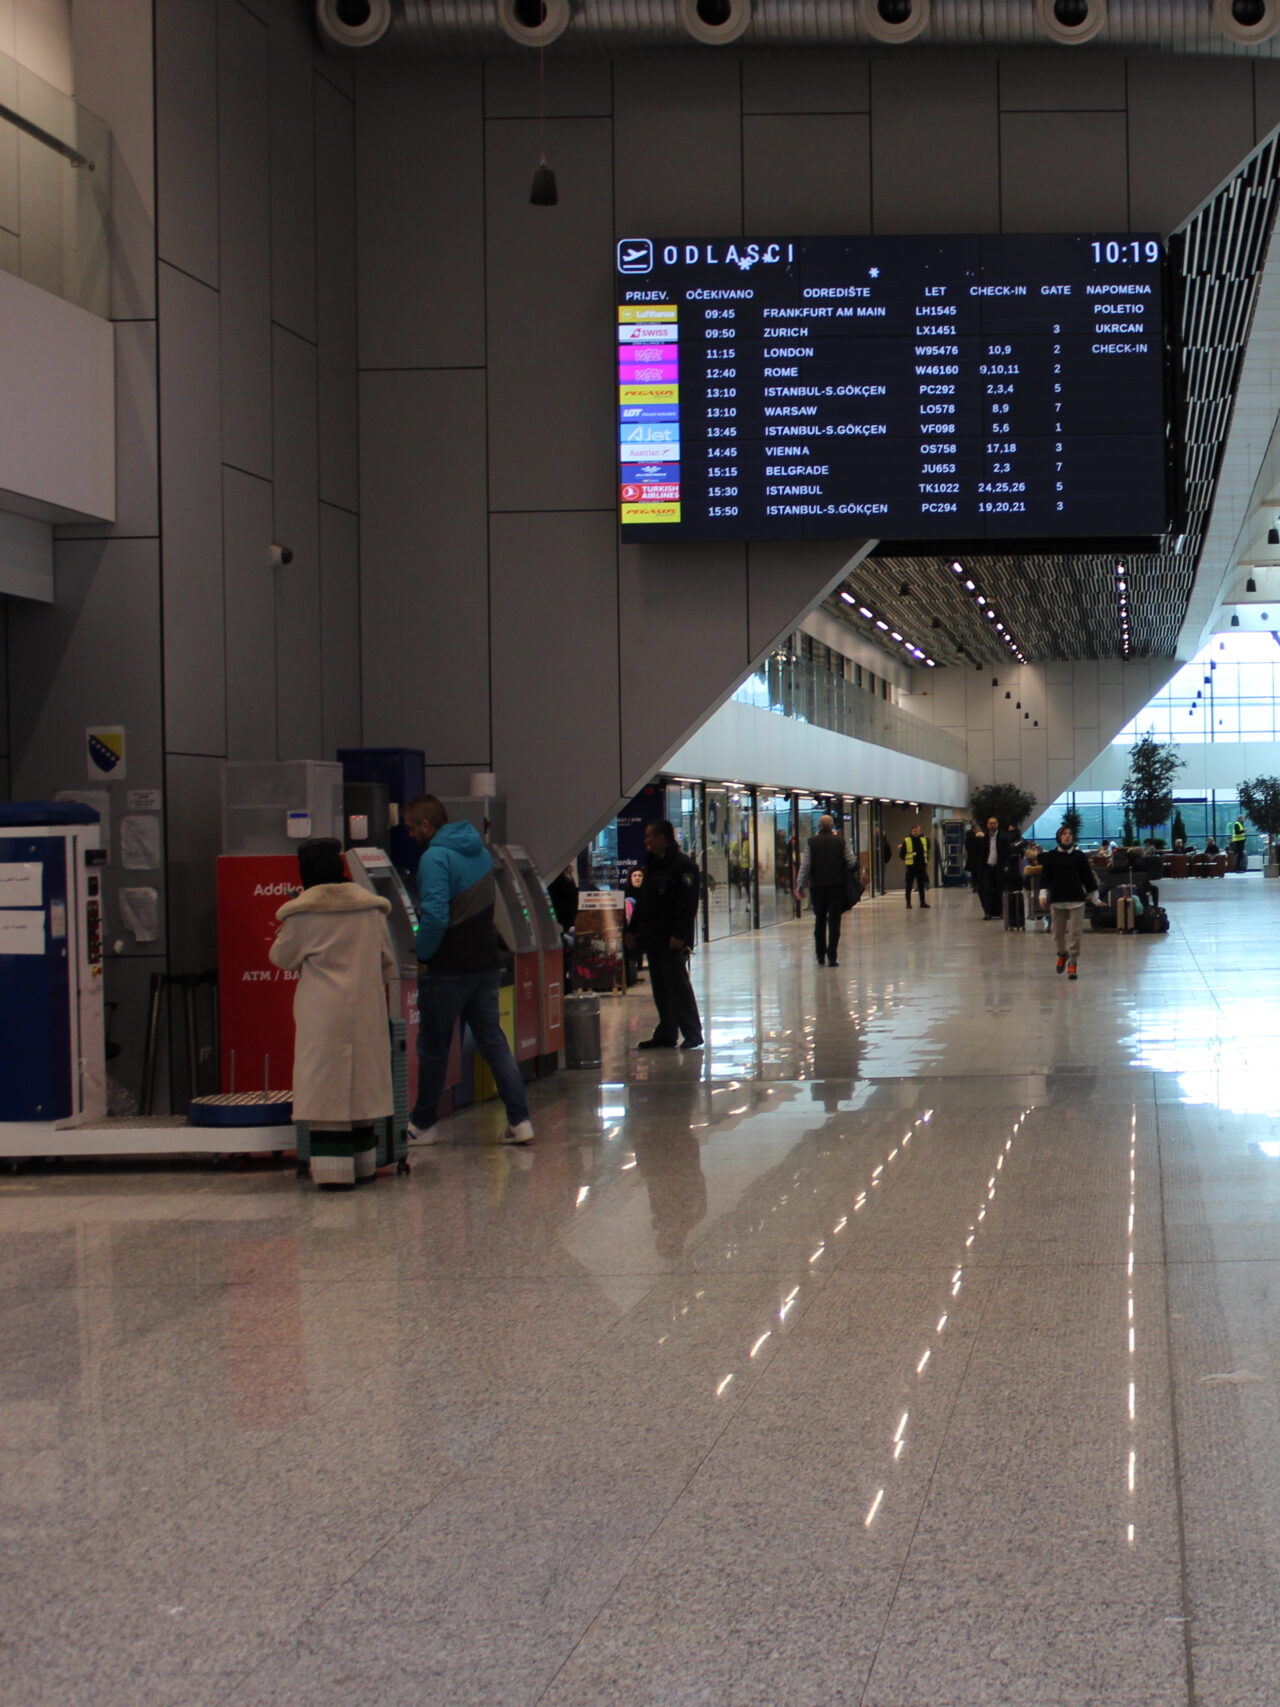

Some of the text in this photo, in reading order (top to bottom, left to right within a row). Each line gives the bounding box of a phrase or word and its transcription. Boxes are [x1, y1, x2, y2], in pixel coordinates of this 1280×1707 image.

[664, 244, 794, 265] ODLASCI
[1091, 241, 1158, 263] 10:19
[626, 285, 1151, 300] PRIJEV. OČEKIVANO ODREDIŠTE LET CHECK-IN GATE NAPOMENA
[705, 304, 1144, 319] 09:45 FRANKFURT AM MAIN LH1545 POLETIO
[705, 324, 1143, 338] 09:50 ZURICH LX1451 3 UKRCAN
[707, 344, 1147, 358] 11:15 LONDON W95476 10,9 2 CHECK-IN
[707, 364, 1060, 378] 12:40 ROME W46160 9,10,11 2
[707, 384, 1061, 398] 13:10 ISTANBUL-S.GÖKÇEN PC292 2,3,4 5
[707, 403, 1061, 417] 13:10 WARSAW LO578 8,9 7
[707, 423, 1062, 437] 13:45 ISTANBUL-S.GÖKÇEN VF098 5,6 1
[708, 443, 1062, 457] 14:45 VIENNA OS758 17,18 3
[708, 462, 1062, 477] 15:15 BELGRADE JU653 2,3 7
[709, 482, 1063, 496] 15:30 ISTANBUL TK1022 24,25,26 5
[709, 502, 1063, 516] 15:50 ISTANBUL-S.GÖKÇEN PC294 19,20,21 3
[254, 883, 304, 896] Addiko
[243, 971, 271, 981] ATM
